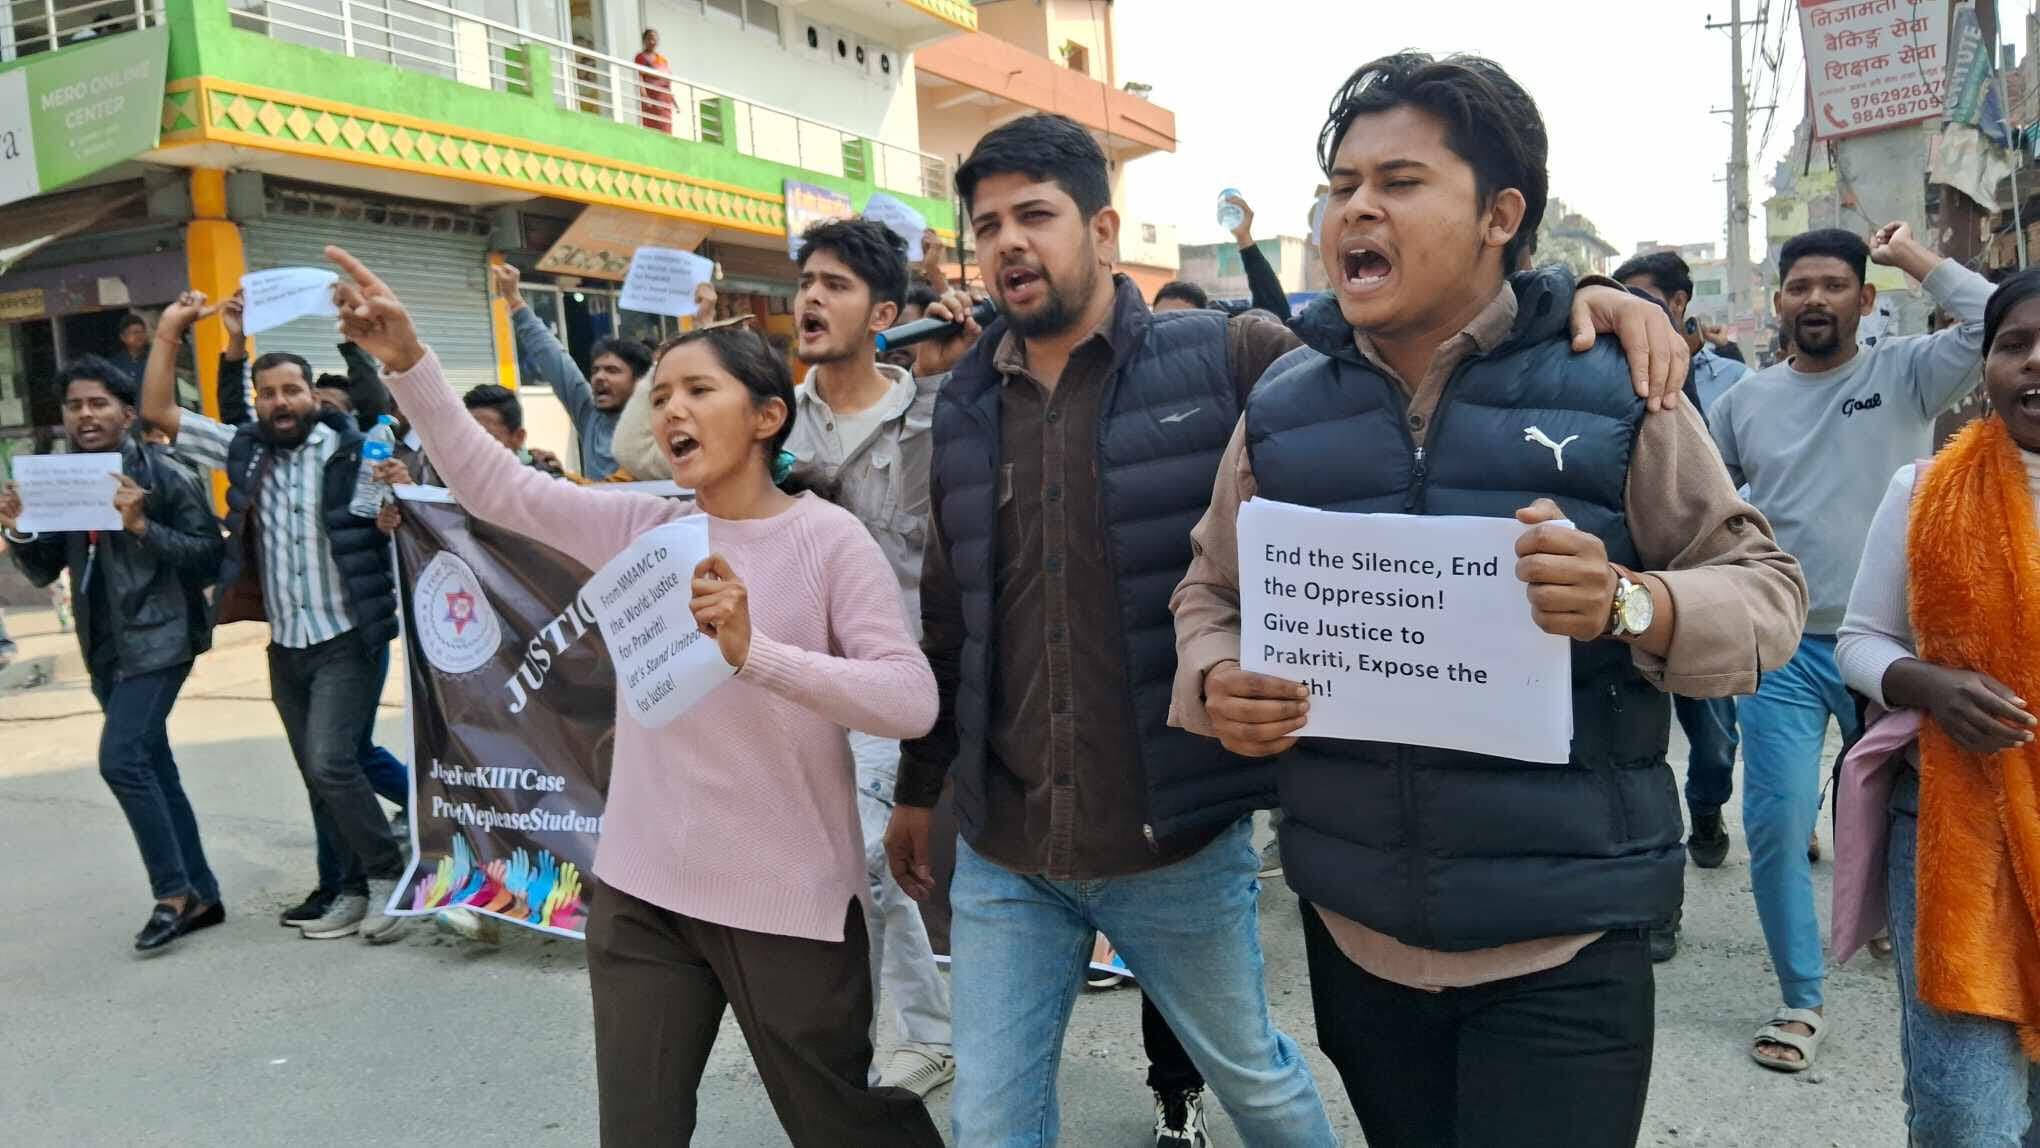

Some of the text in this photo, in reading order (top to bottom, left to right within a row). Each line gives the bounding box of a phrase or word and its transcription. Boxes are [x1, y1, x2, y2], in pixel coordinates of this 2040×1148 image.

[1890, 16, 1929, 38] सेवा
[1824, 53, 1890, 81] शिक्षक
[1898, 43, 1937, 65] सेवा
[40, 81, 87, 112] MERO
[65, 95, 127, 129] CENTER
[1842, 393, 1882, 418] Goal
[1265, 544, 1498, 579] End the Silence, End
[600, 585, 623, 609] From
[654, 547, 668, 564] to
[1264, 577, 1445, 610] the Oppression!
[609, 619, 626, 636] the
[648, 571, 679, 605] Justice
[1264, 613, 1425, 645] Give Justice to
[618, 642, 633, 661] for
[646, 648, 669, 673] Stand
[1264, 645, 1488, 684] Prakriti, Expose the
[636, 694, 650, 712] for
